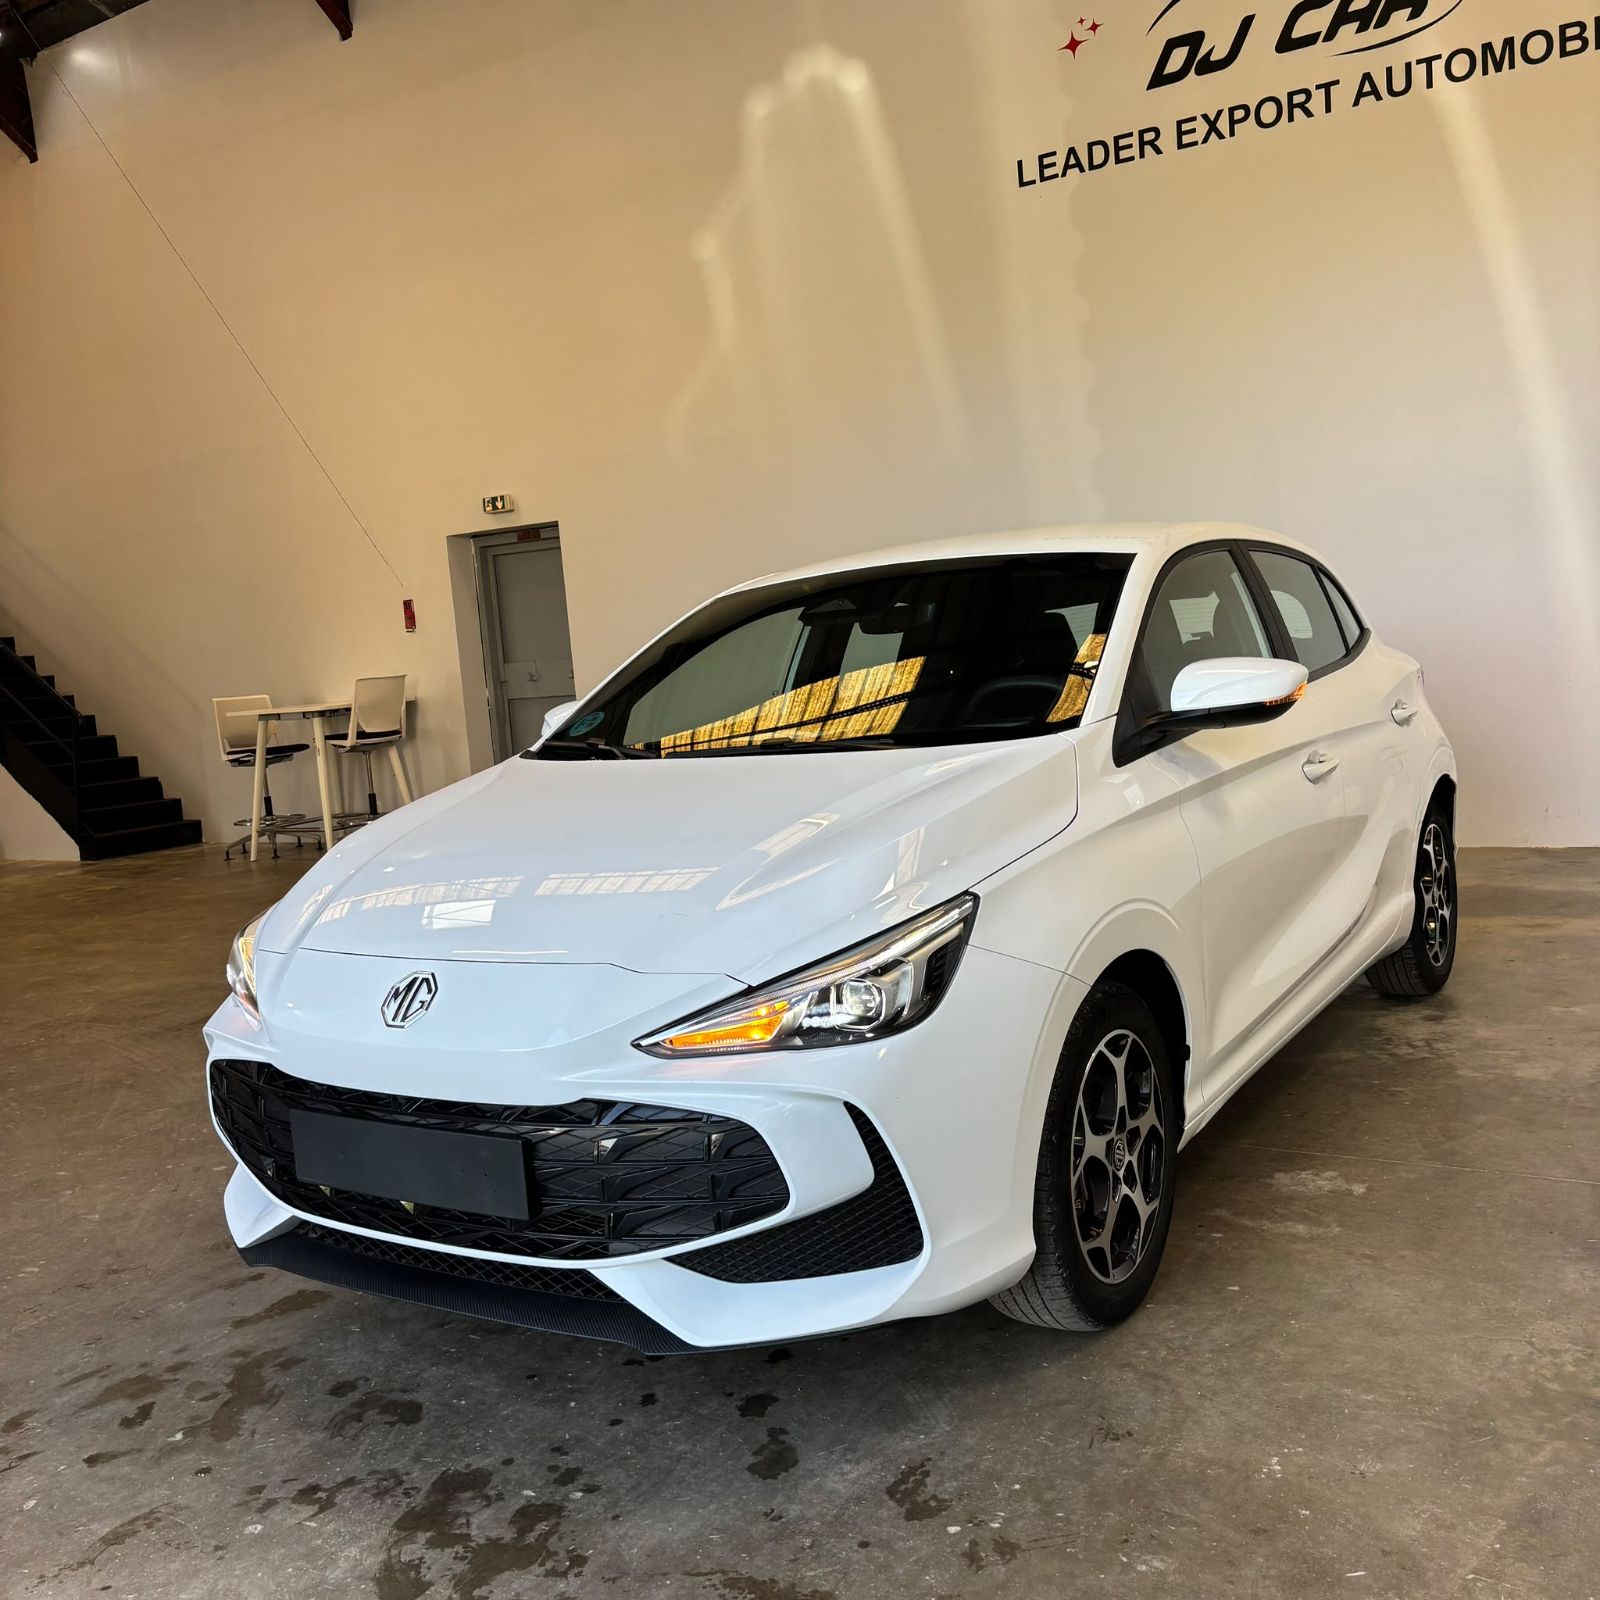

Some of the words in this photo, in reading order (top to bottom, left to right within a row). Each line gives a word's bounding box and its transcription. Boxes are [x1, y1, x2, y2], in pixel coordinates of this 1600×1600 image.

[1146, 14, 1256, 91] DJ
[1016, 126, 1164, 188] LEADER
[1175, 79, 1340, 151] EXPORT
[385, 975, 434, 1023] MG
